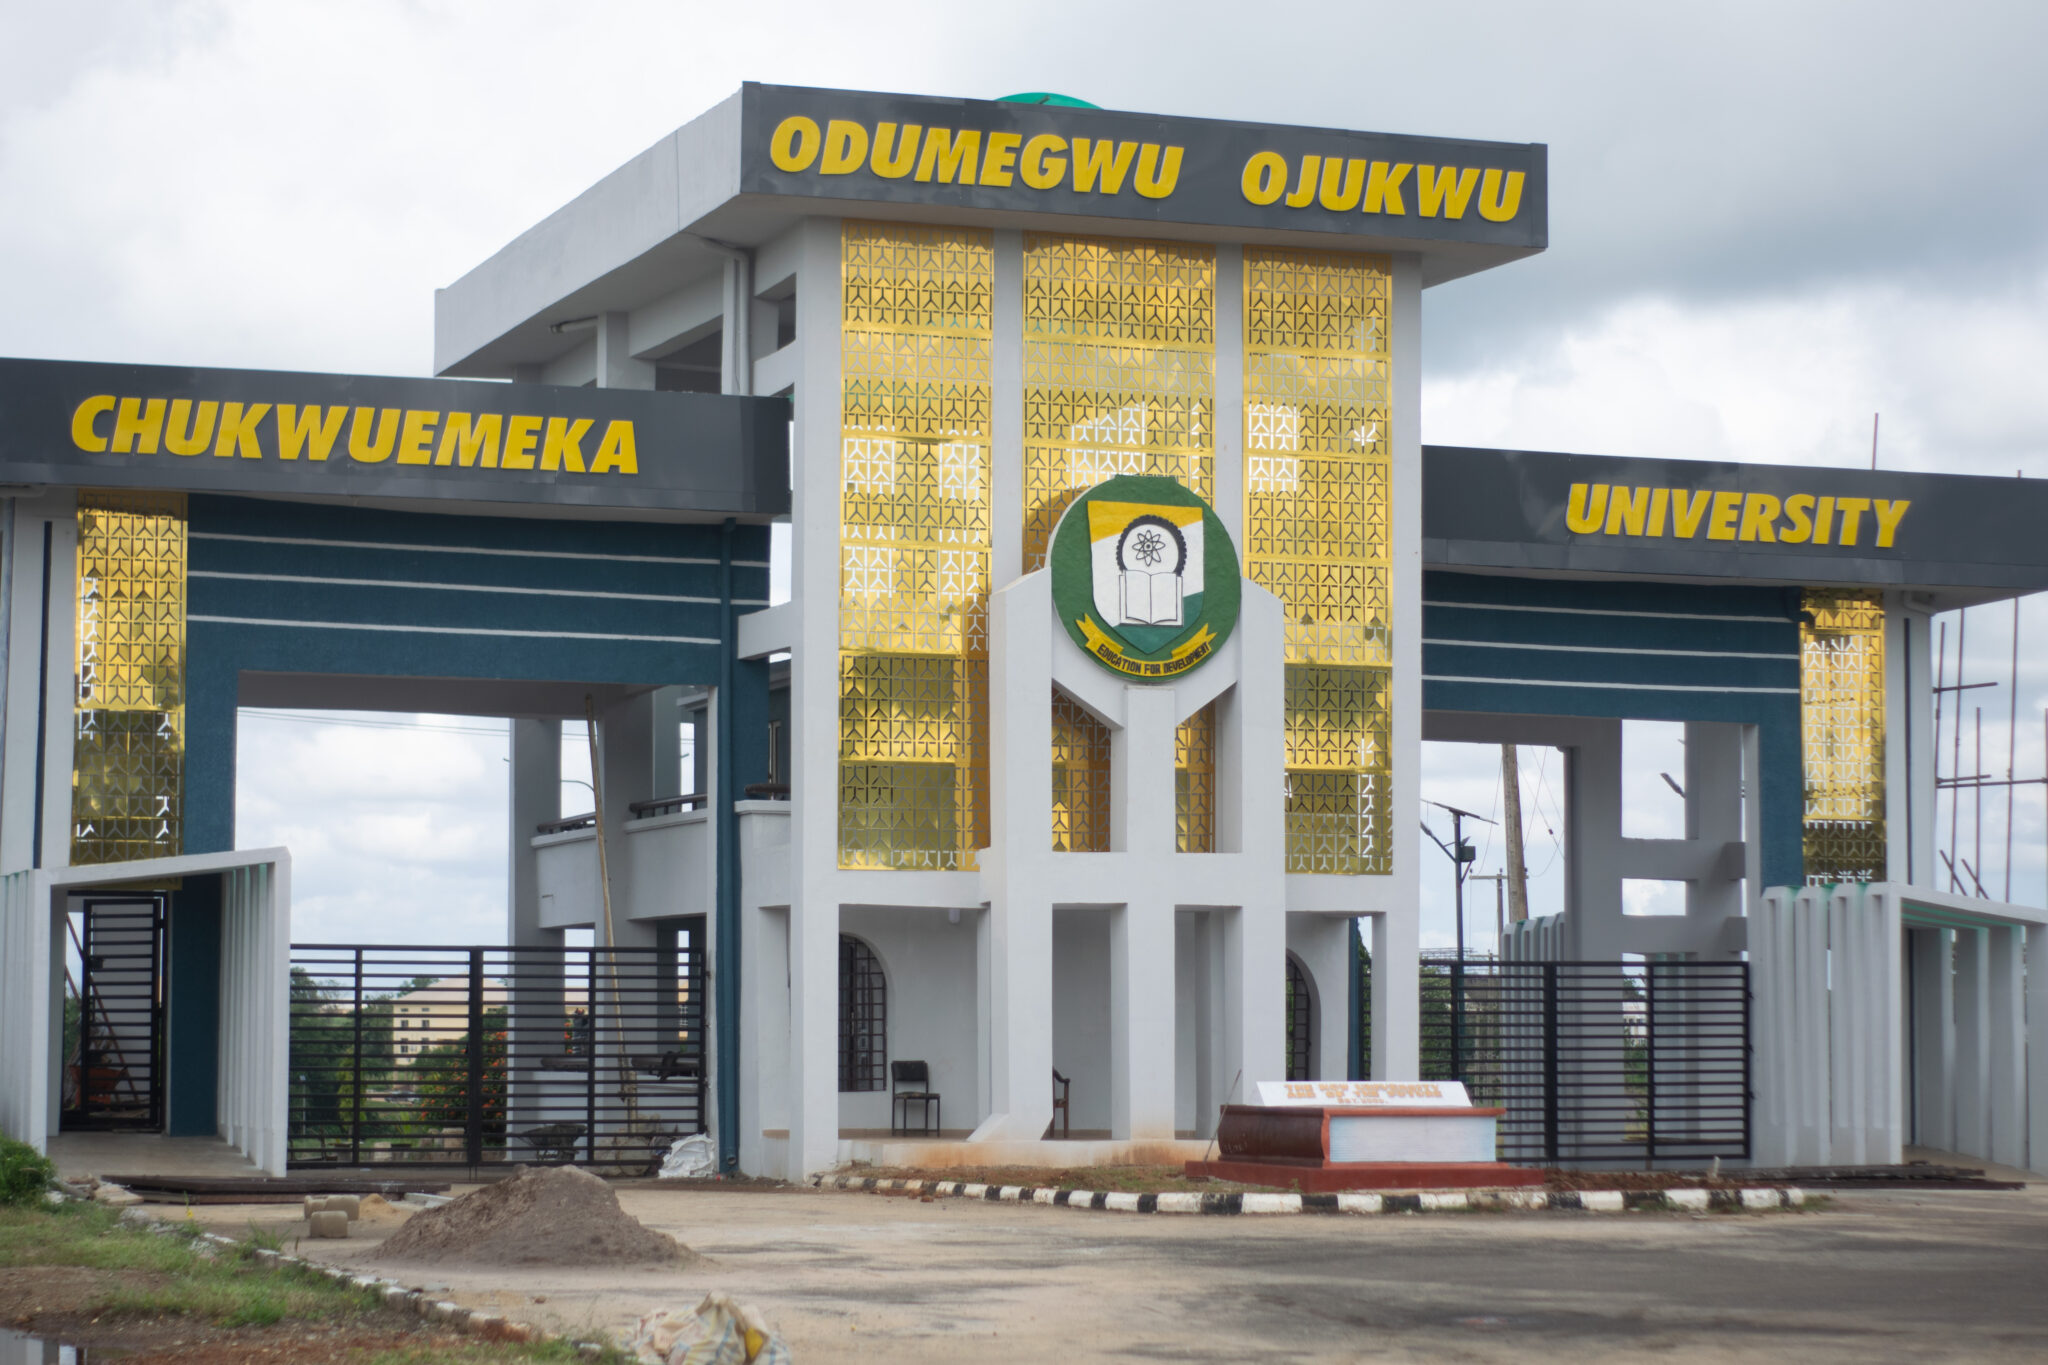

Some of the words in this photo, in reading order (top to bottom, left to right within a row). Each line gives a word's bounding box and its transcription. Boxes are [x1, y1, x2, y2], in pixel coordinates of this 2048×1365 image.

[769, 115, 1185, 199] ODUMEGWU
[1241, 151, 1526, 222] OJUKWU
[71, 394, 639, 474] CHUKWUEMEKA
[1566, 483, 1911, 548] UNIVERSITY
[1097, 644, 1141, 674] EDUCATION
[1144, 664, 1161, 674] FOR
[1163, 642, 1209, 673] DEVELOPMENT
